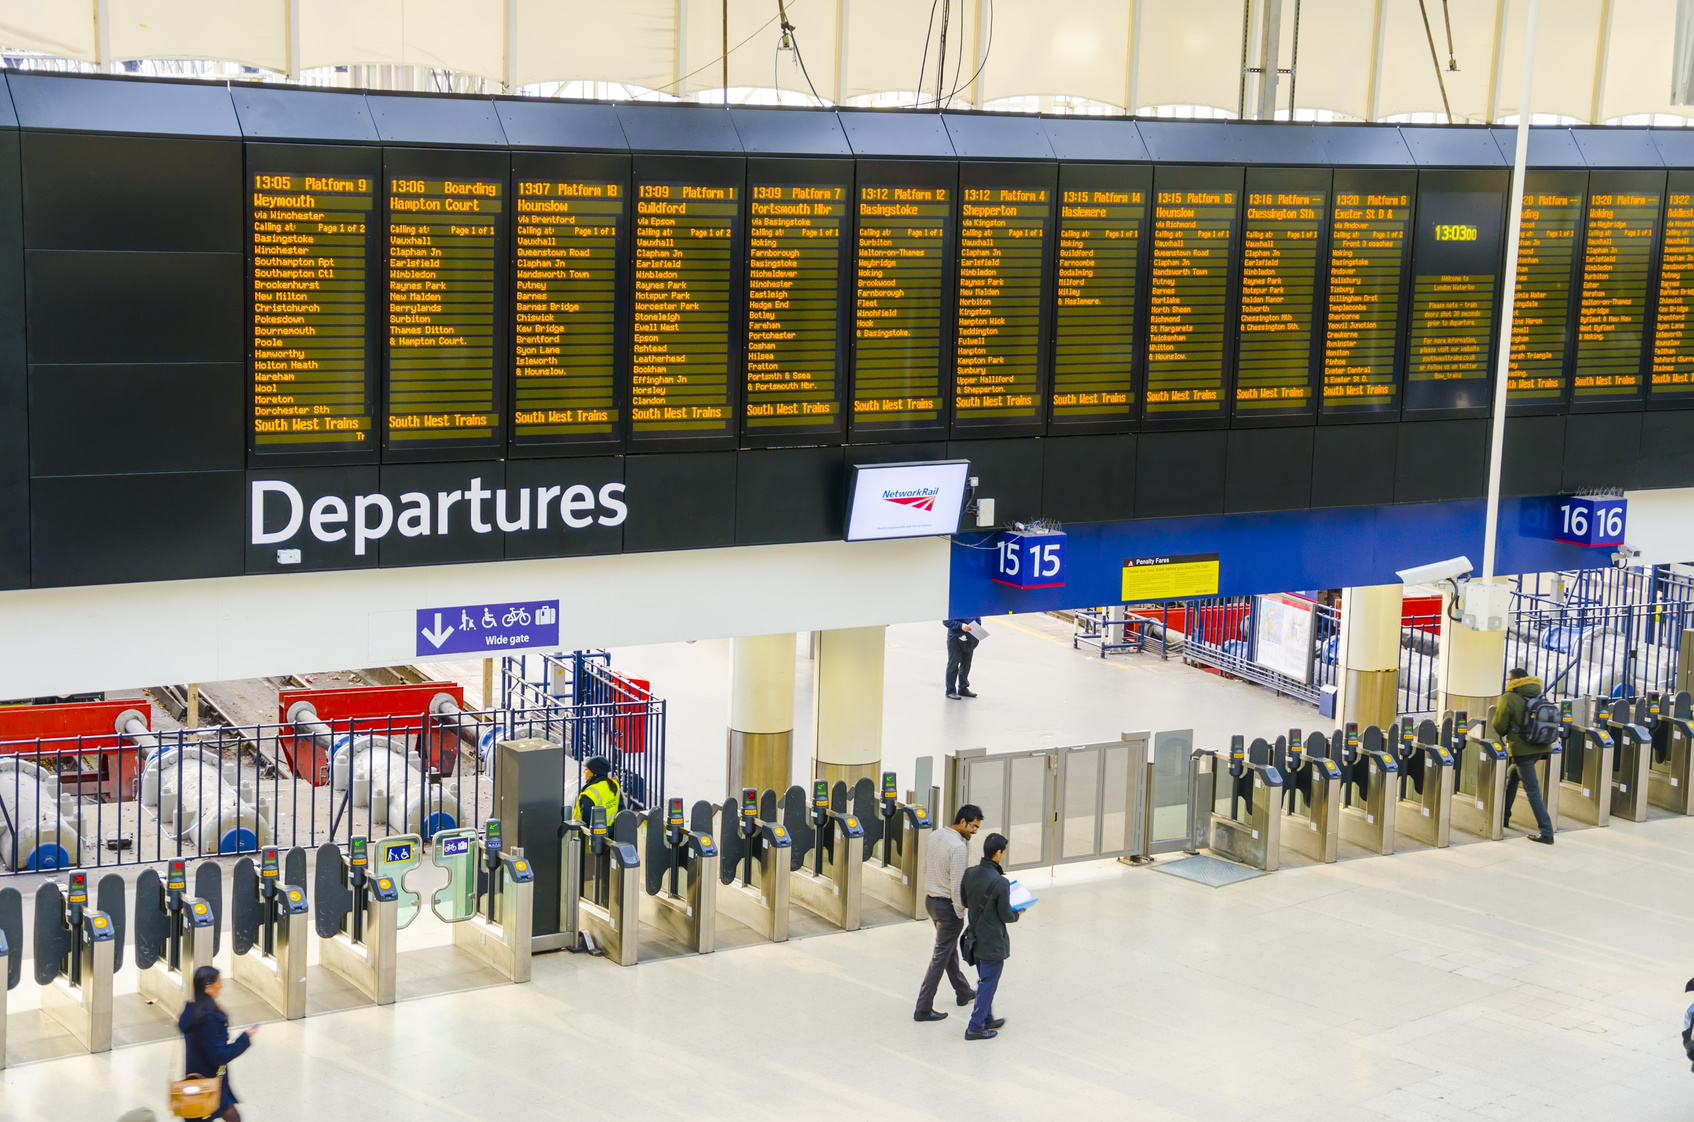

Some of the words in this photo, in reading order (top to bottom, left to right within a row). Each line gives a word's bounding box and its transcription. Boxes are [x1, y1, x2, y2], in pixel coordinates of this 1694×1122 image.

[256, 175, 290, 189] 13:05
[305, 177, 353, 191] Platform
[358, 179, 366, 191] 9
[392, 180, 424, 192] 13:06
[444, 181, 496, 196] Boarding
[519, 182, 550, 194] 13:07
[558, 183, 601, 196] Platform
[607, 184, 617, 196] 18
[640, 185, 668, 197] 13:09
[682, 186, 723, 198] Platform
[729, 187, 732, 198] 1
[754, 187, 781, 198] 13:09
[792, 187, 830, 199] Platform
[834, 188, 840, 199] 7
[862, 188, 888, 199] 13:12
[894, 188, 931, 200] Platform
[936, 189, 945, 200] 12
[965, 189, 990, 200] 13:12
[1000, 190, 1036, 200] Platform
[1038, 190, 1044, 200] 4
[254, 193, 314, 209] Weymouth
[1064, 191, 1088, 202] 13:15
[1094, 192, 1128, 202] Platform
[1132, 192, 1140, 202] 14
[1158, 192, 1181, 203] 13:15
[1187, 193, 1220, 203] Platform
[1223, 193, 1232, 203] 16
[390, 197, 440, 211] Hampton
[445, 198, 479, 211] Court
[518, 199, 568, 211] Hounslow
[638, 202, 685, 213] Guildford
[752, 202, 810, 214] Portsmouth
[814, 203, 832, 214] Hbr
[860, 203, 918, 216] Basingstoke
[254, 210, 267, 218] via
[270, 210, 324, 220] Winchester
[963, 204, 1016, 217] Shepperton
[1062, 206, 1106, 217] Haslemere
[1156, 207, 1194, 217] Hounslow
[531, 215, 574, 223] Brentford
[650, 217, 675, 226] Epsom
[254, 222, 281, 232] Calling
[284, 222, 295, 231] at:
[318, 223, 337, 233] Page
[340, 224, 344, 232] 1
[347, 224, 356, 232] of
[359, 224, 365, 232] 2
[254, 233, 313, 244] Basingstoke
[390, 236, 430, 244] Vauxhall
[390, 247, 426, 257] Clapham
[430, 248, 441, 256] Jn
[517, 248, 566, 256] Queenstown
[750, 249, 799, 258] Farnborough
[254, 257, 314, 267] Southampton
[318, 258, 334, 267] Apt
[636, 259, 680, 267] Earlsfield
[390, 281, 421, 291] Raynes
[425, 281, 445, 289] Park
[254, 292, 272, 300] New
[276, 292, 307, 300] Milton
[254, 303, 320, 311] Christchurch
[390, 314, 430, 322] Surbiton
[516, 313, 553, 321] Chiswick
[634, 312, 680, 322] Stoneleigh
[749, 311, 774, 320] Botley
[255, 326, 315, 335] Bournemouth
[535, 324, 564, 333] Bridge
[634, 344, 666, 352] Ashtead
[633, 354, 685, 362] Leatherhead
[956, 396, 980, 407] South
[983, 395, 1002, 406] West
[1006, 394, 1031, 405] Trains
[1053, 394, 1076, 404] South
[1079, 393, 1098, 403] West
[1101, 392, 1126, 402] Trains
[1146, 391, 1168, 401] South
[1171, 390, 1189, 400] West
[1192, 389, 1216, 399] Trains
[747, 404, 773, 415] South
[776, 403, 798, 414] West
[802, 402, 829, 413] Trains
[854, 400, 879, 411] South
[882, 399, 903, 410] West
[906, 398, 933, 409] Trains
[515, 411, 544, 423] South
[548, 410, 572, 422] West
[576, 409, 607, 421] Trains
[632, 407, 660, 419] South
[664, 407, 687, 418] West
[691, 406, 721, 418] Trains
[255, 418, 287, 431] South
[292, 417, 319, 430] West
[324, 416, 358, 429] Trains
[389, 415, 420, 427] South
[424, 414, 449, 426] West
[454, 413, 486, 425] Trains
[251, 477, 628, 556] Departures
[1561, 505, 1588, 536] 16
[1597, 508, 1622, 537] 16
[997, 541, 1019, 575] 15
[1030, 544, 1060, 577] 15
[486, 635, 507, 645] Wide
[510, 634, 529, 646] gate
